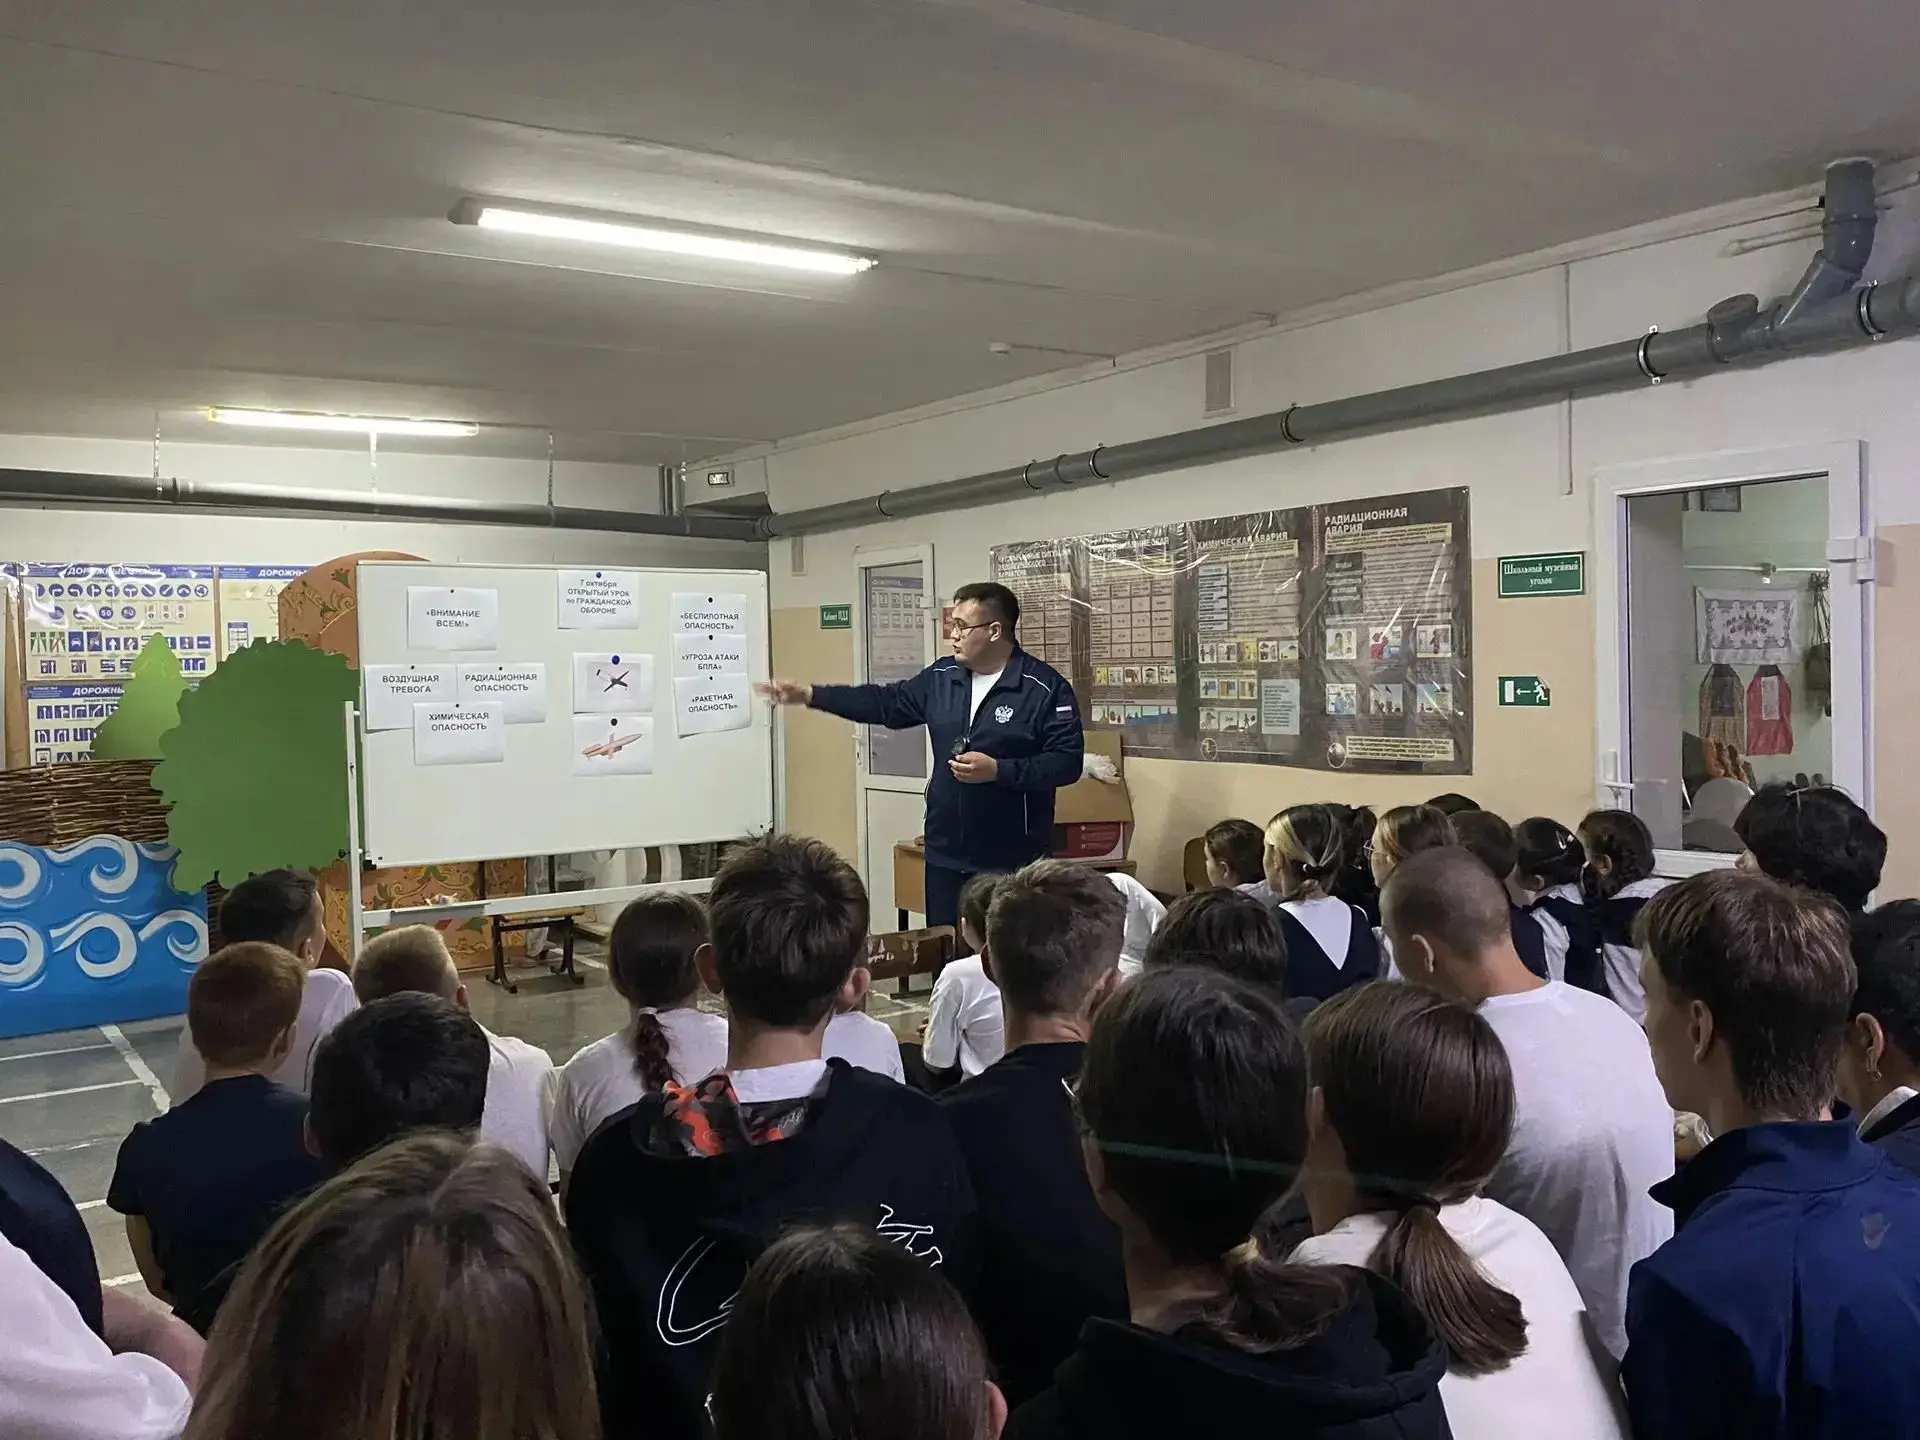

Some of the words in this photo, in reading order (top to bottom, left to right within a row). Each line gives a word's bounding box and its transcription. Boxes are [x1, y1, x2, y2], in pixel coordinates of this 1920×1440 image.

[1324, 507, 1409, 526] РАДИАЦИОННАЯ
[1325, 523, 1364, 537] АВАРИЯ
[1197, 535, 1253, 550] ХИМИЧЕСКАЯ
[1254, 531, 1288, 543] АВАРИЯ
[1503, 563, 1543, 575] Школьный
[1544, 560, 1579, 575] музейный
[586, 580, 618, 588] октября
[1529, 577, 1553, 588] уголок
[567, 588, 610, 597] ОТКРЫТЫЙ
[611, 590, 631, 598] УРОК
[576, 597, 632, 606] ГРАЖДАНСКОЙ
[426, 608, 481, 618] «ВНИМАНИЕ
[580, 606, 617, 614] ОБОРОНЕ
[680, 612, 739, 621] «БЕСПИЛОТНАЯ
[436, 619, 469, 628] ВСЕМ!»
[684, 622, 735, 630] ОПАСНОСТЬ»
[681, 653, 714, 661] «УГРОЗА
[714, 653, 740, 661] АТАКИ
[382, 674, 440, 683] ВОЗДУШНАЯ
[465, 673, 538, 682] РАДИАЦИОННАЯ
[390, 685, 432, 694] ТРЕВОГА
[474, 684, 529, 692] ОПАСНОСТЬ
[691, 693, 734, 703] «РАКЕТНАЯ
[688, 703, 738, 713] ОПАСНОСТЬ»
[428, 712, 490, 721] ХИМИЧЕСКАЯ
[431, 723, 488, 732] ОПАСНОСТЬ
